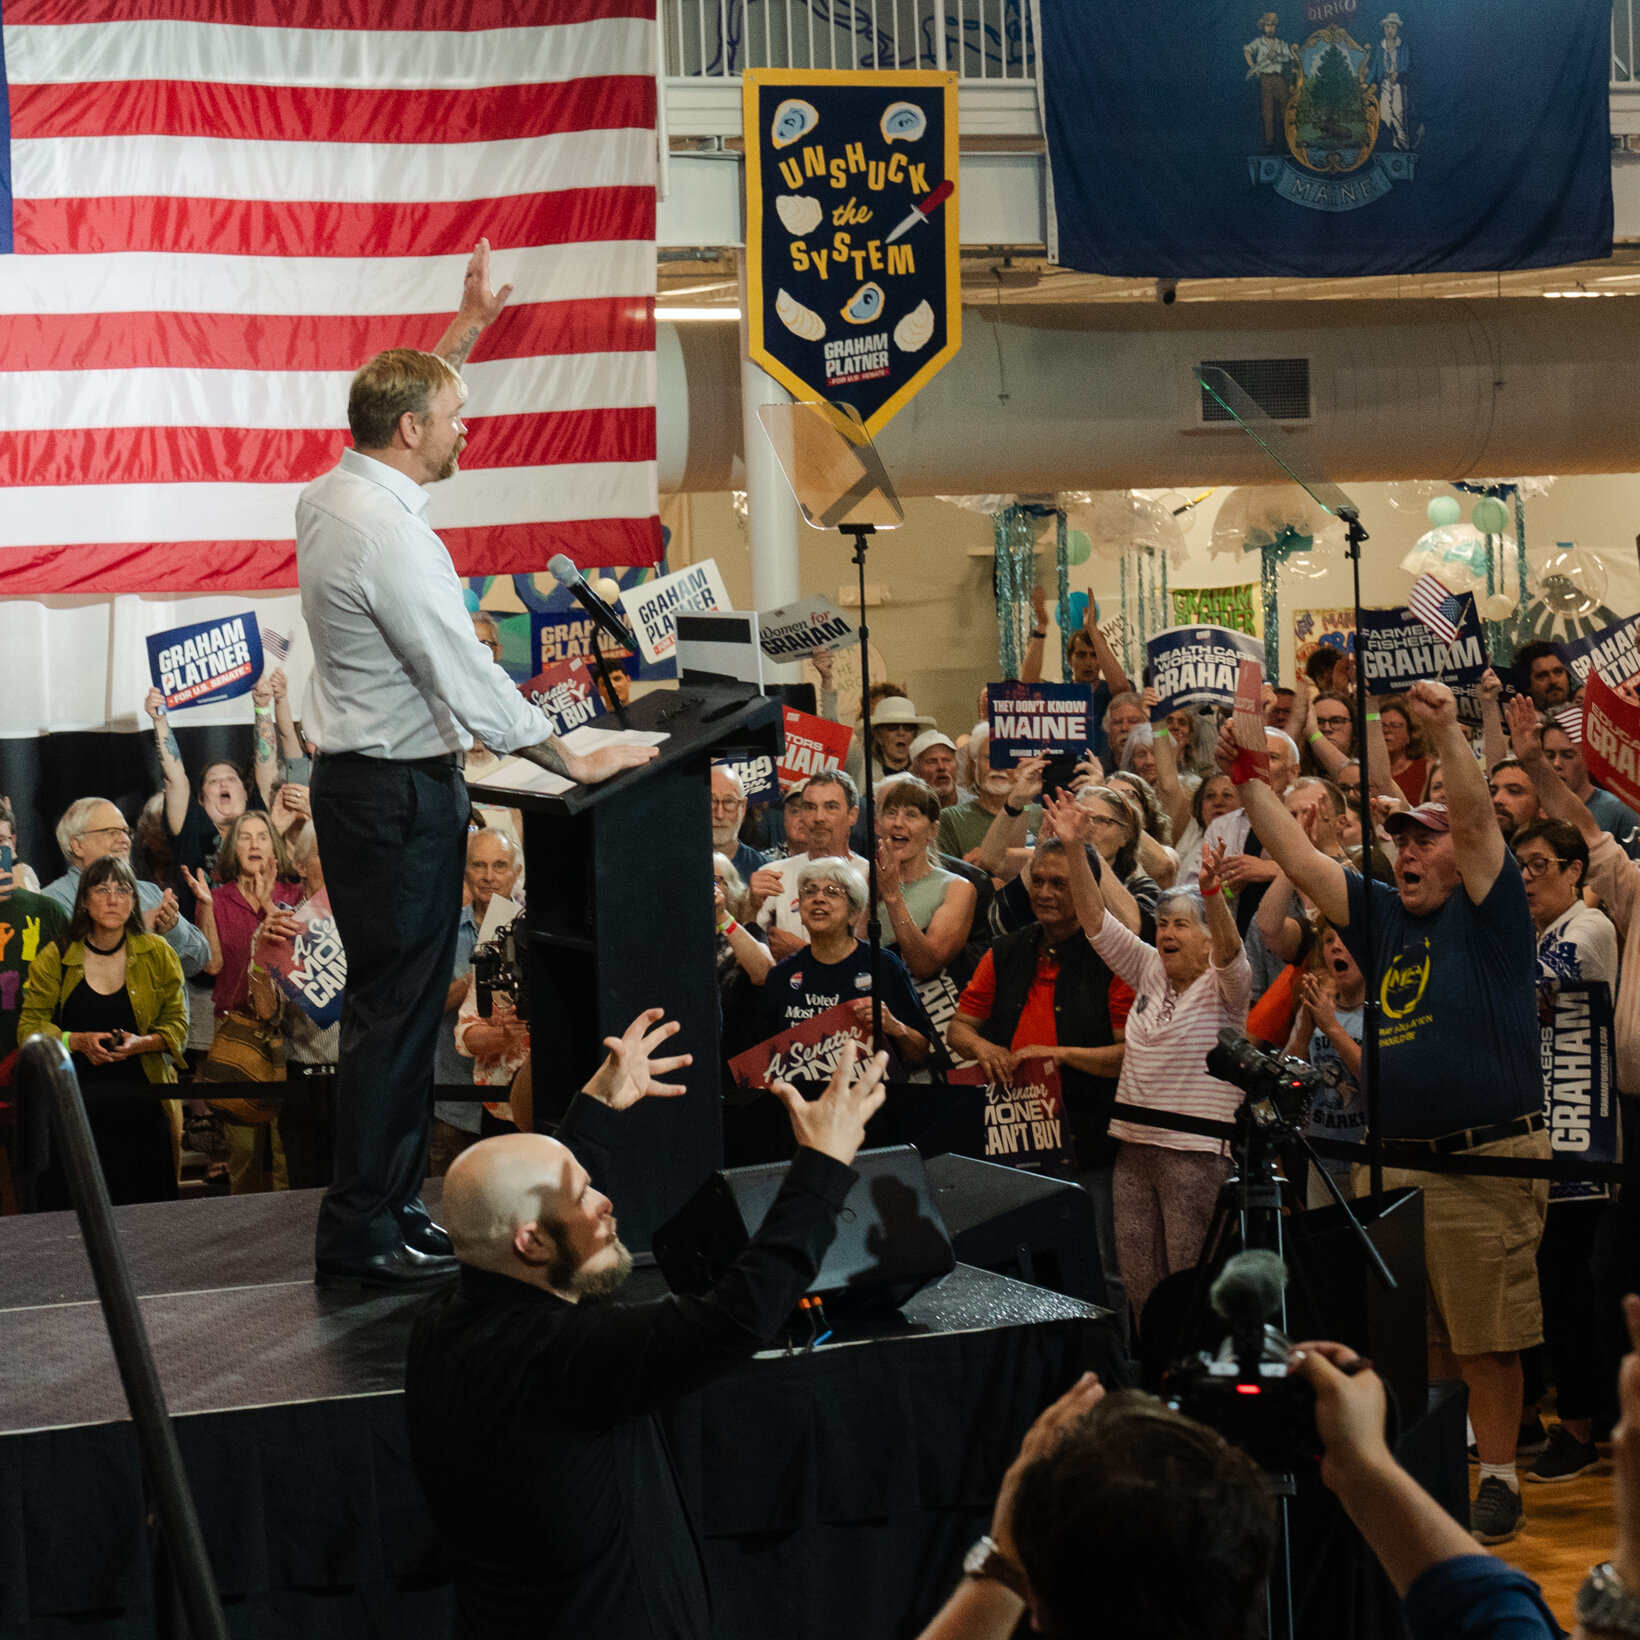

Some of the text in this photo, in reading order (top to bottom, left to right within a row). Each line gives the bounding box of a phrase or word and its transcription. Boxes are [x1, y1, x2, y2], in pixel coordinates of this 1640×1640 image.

[779, 142, 930, 194] UNSHUCK
[1290, 178, 1373, 204] MANE
[832, 197, 873, 226] the
[790, 231, 915, 280] SYSTEM
[824, 333, 888, 360] GRAHAM
[825, 351, 889, 378] PLATNER
[638, 567, 709, 625] GRAHAM
[1173, 584, 1254, 615] GRAHAM
[760, 611, 830, 640] Women for
[760, 617, 852, 655] GRAHAM
[158, 617, 247, 674] GRAHAM
[1154, 645, 1211, 667] HEALTH
[1363, 635, 1483, 679] GRAHAM
[1368, 633, 1444, 651] FISHERS
[161, 640, 251, 697] PLATNER
[1157, 653, 1238, 673] WORKERS
[173, 689, 193, 703] FOR
[192, 683, 210, 698] U.S.
[210, 666, 246, 688] SENATE
[530, 678, 578, 708] Senator
[1153, 662, 1241, 703] GRAHA
[560, 696, 597, 731] BUY
[993, 700, 1088, 714] THEY DON'T KNOW
[994, 715, 1088, 740] MAINE
[784, 1005, 815, 1019] Most
[805, 993, 840, 1006] Voted
[763, 1026, 863, 1083] A Senator
[1551, 991, 1592, 1152] GRAHAM
[1001, 1082, 1049, 1102] Senator
[985, 1119, 1063, 1156] AN'T BUY
